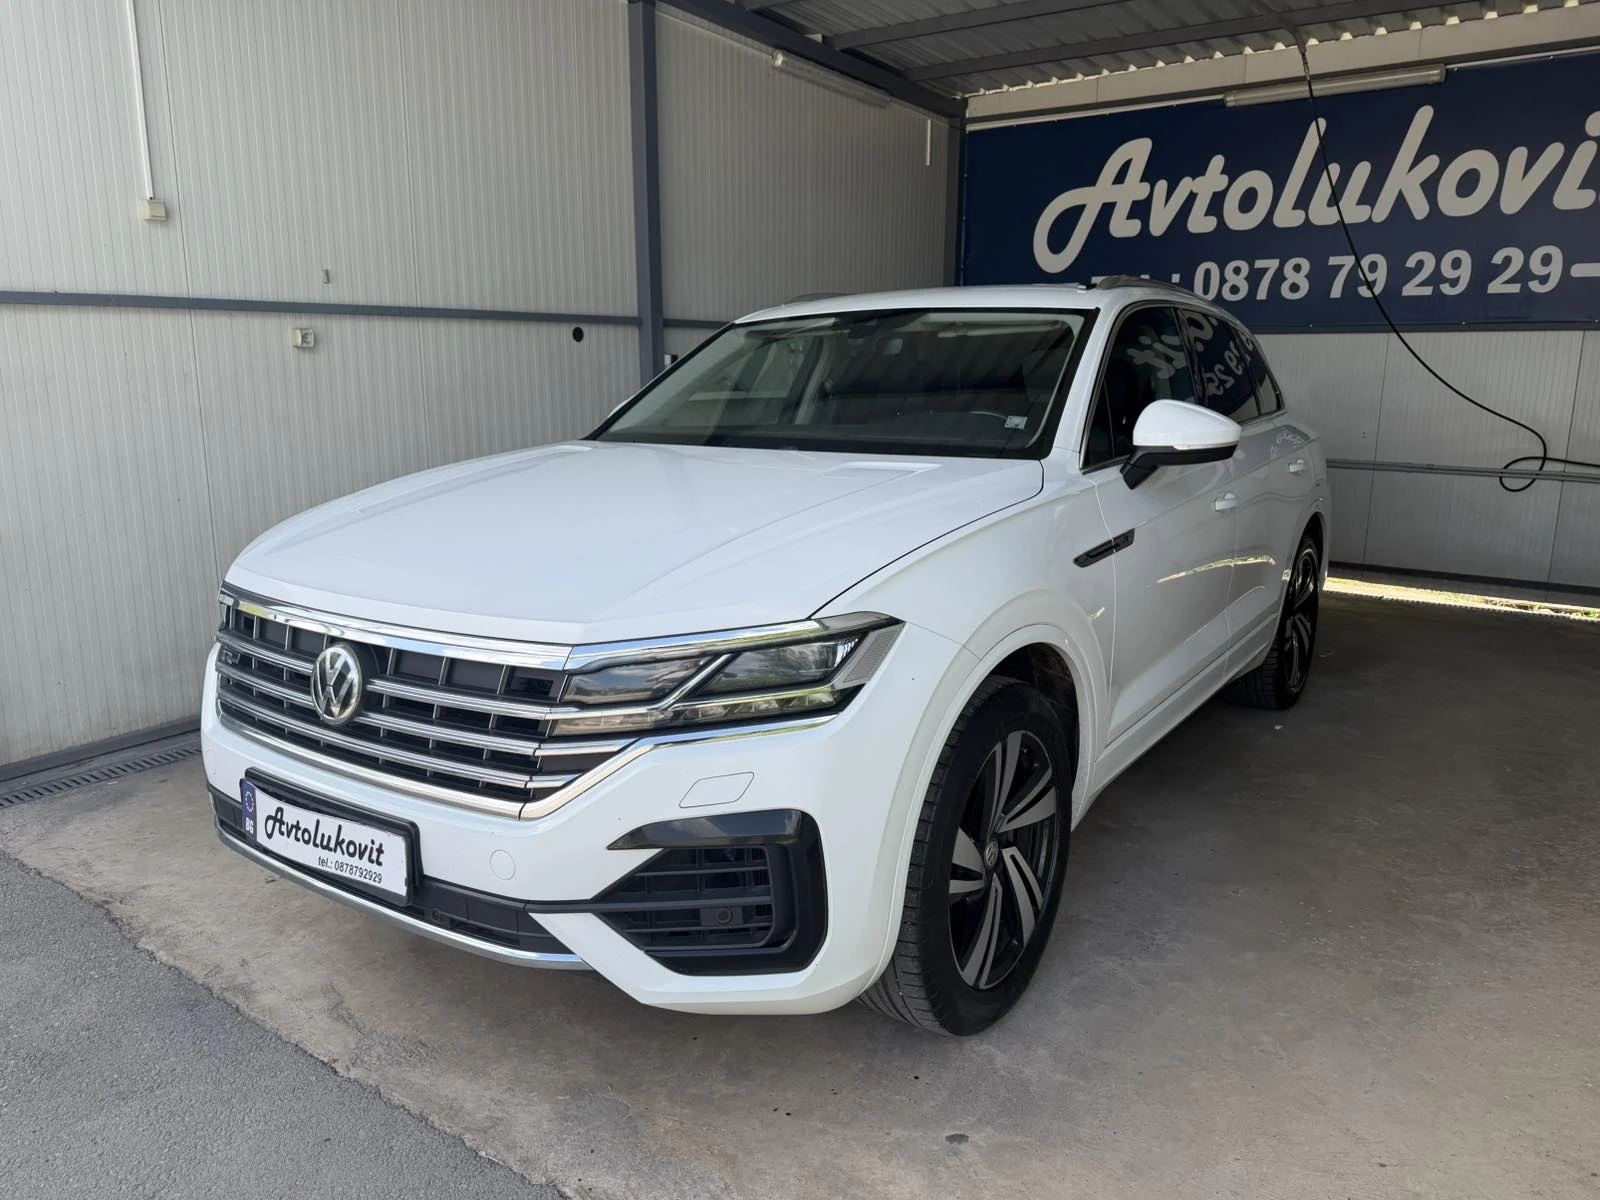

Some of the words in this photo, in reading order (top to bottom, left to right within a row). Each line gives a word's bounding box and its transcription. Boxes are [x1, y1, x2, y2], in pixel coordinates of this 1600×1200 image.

[1034, 105, 1600, 274] Avtolukovi
[1193, 258, 1311, 302] 0878
[1327, 253, 1388, 299] 79
[1401, 250, 1472, 297] 29
[1486, 245, 1564, 293] 29
[245, 817, 254, 834] BG
[264, 806, 385, 867] Avtolukovit
[318, 855, 333, 869] tel.:
[334, 859, 383, 884] 0878792929
